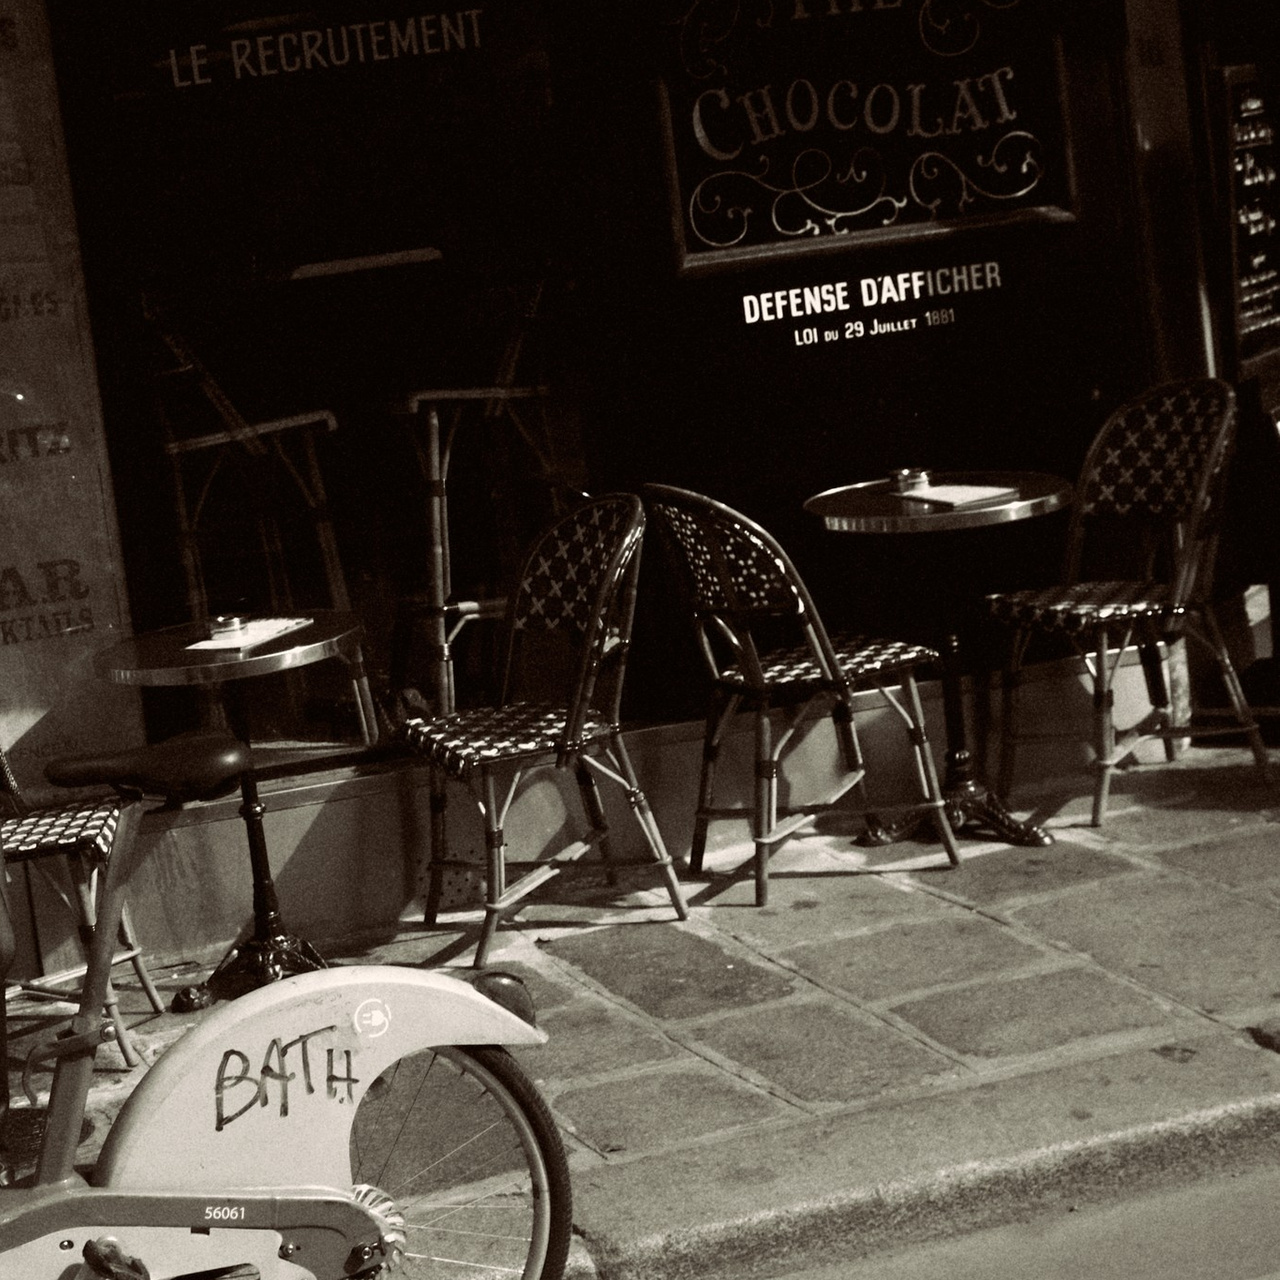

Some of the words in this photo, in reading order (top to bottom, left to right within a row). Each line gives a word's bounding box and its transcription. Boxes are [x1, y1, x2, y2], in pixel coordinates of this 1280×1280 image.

[170, 44, 212, 88] LE
[230, 8, 484, 80] RECRUTEMENT
[692, 67, 1018, 162] CHOCOLAT
[742, 280, 851, 325] DEFENSE
[860, 261, 1003, 308] D'AFFICHER
[794, 326, 819, 347] LOI
[824, 329, 839, 343] DU
[844, 320, 865, 340] 29
[924, 307, 956, 327] 1881
[214, 1025, 359, 1132] BATH
[204, 1206, 246, 1220] 56061
